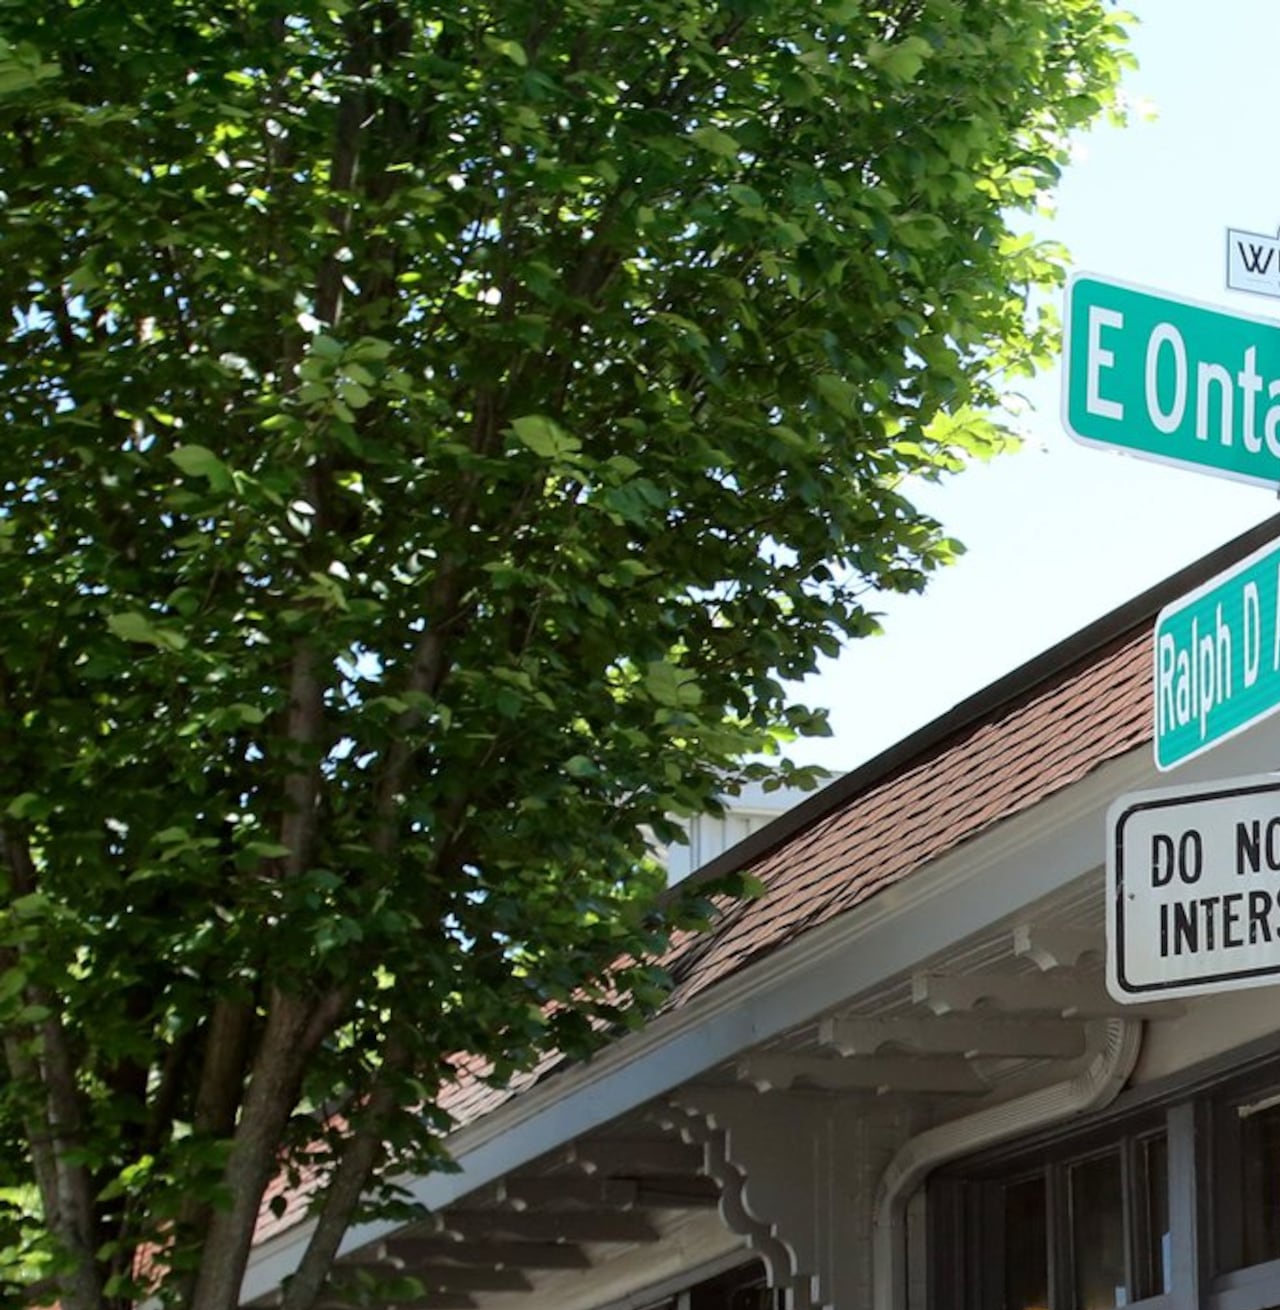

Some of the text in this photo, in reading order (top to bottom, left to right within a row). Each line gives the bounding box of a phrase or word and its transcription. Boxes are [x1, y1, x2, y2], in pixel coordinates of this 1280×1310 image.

[1086, 305, 1124, 420] E
[1159, 631, 1232, 741] Ralph
[1243, 581, 1261, 687] D
[1151, 829, 1202, 888] DO
